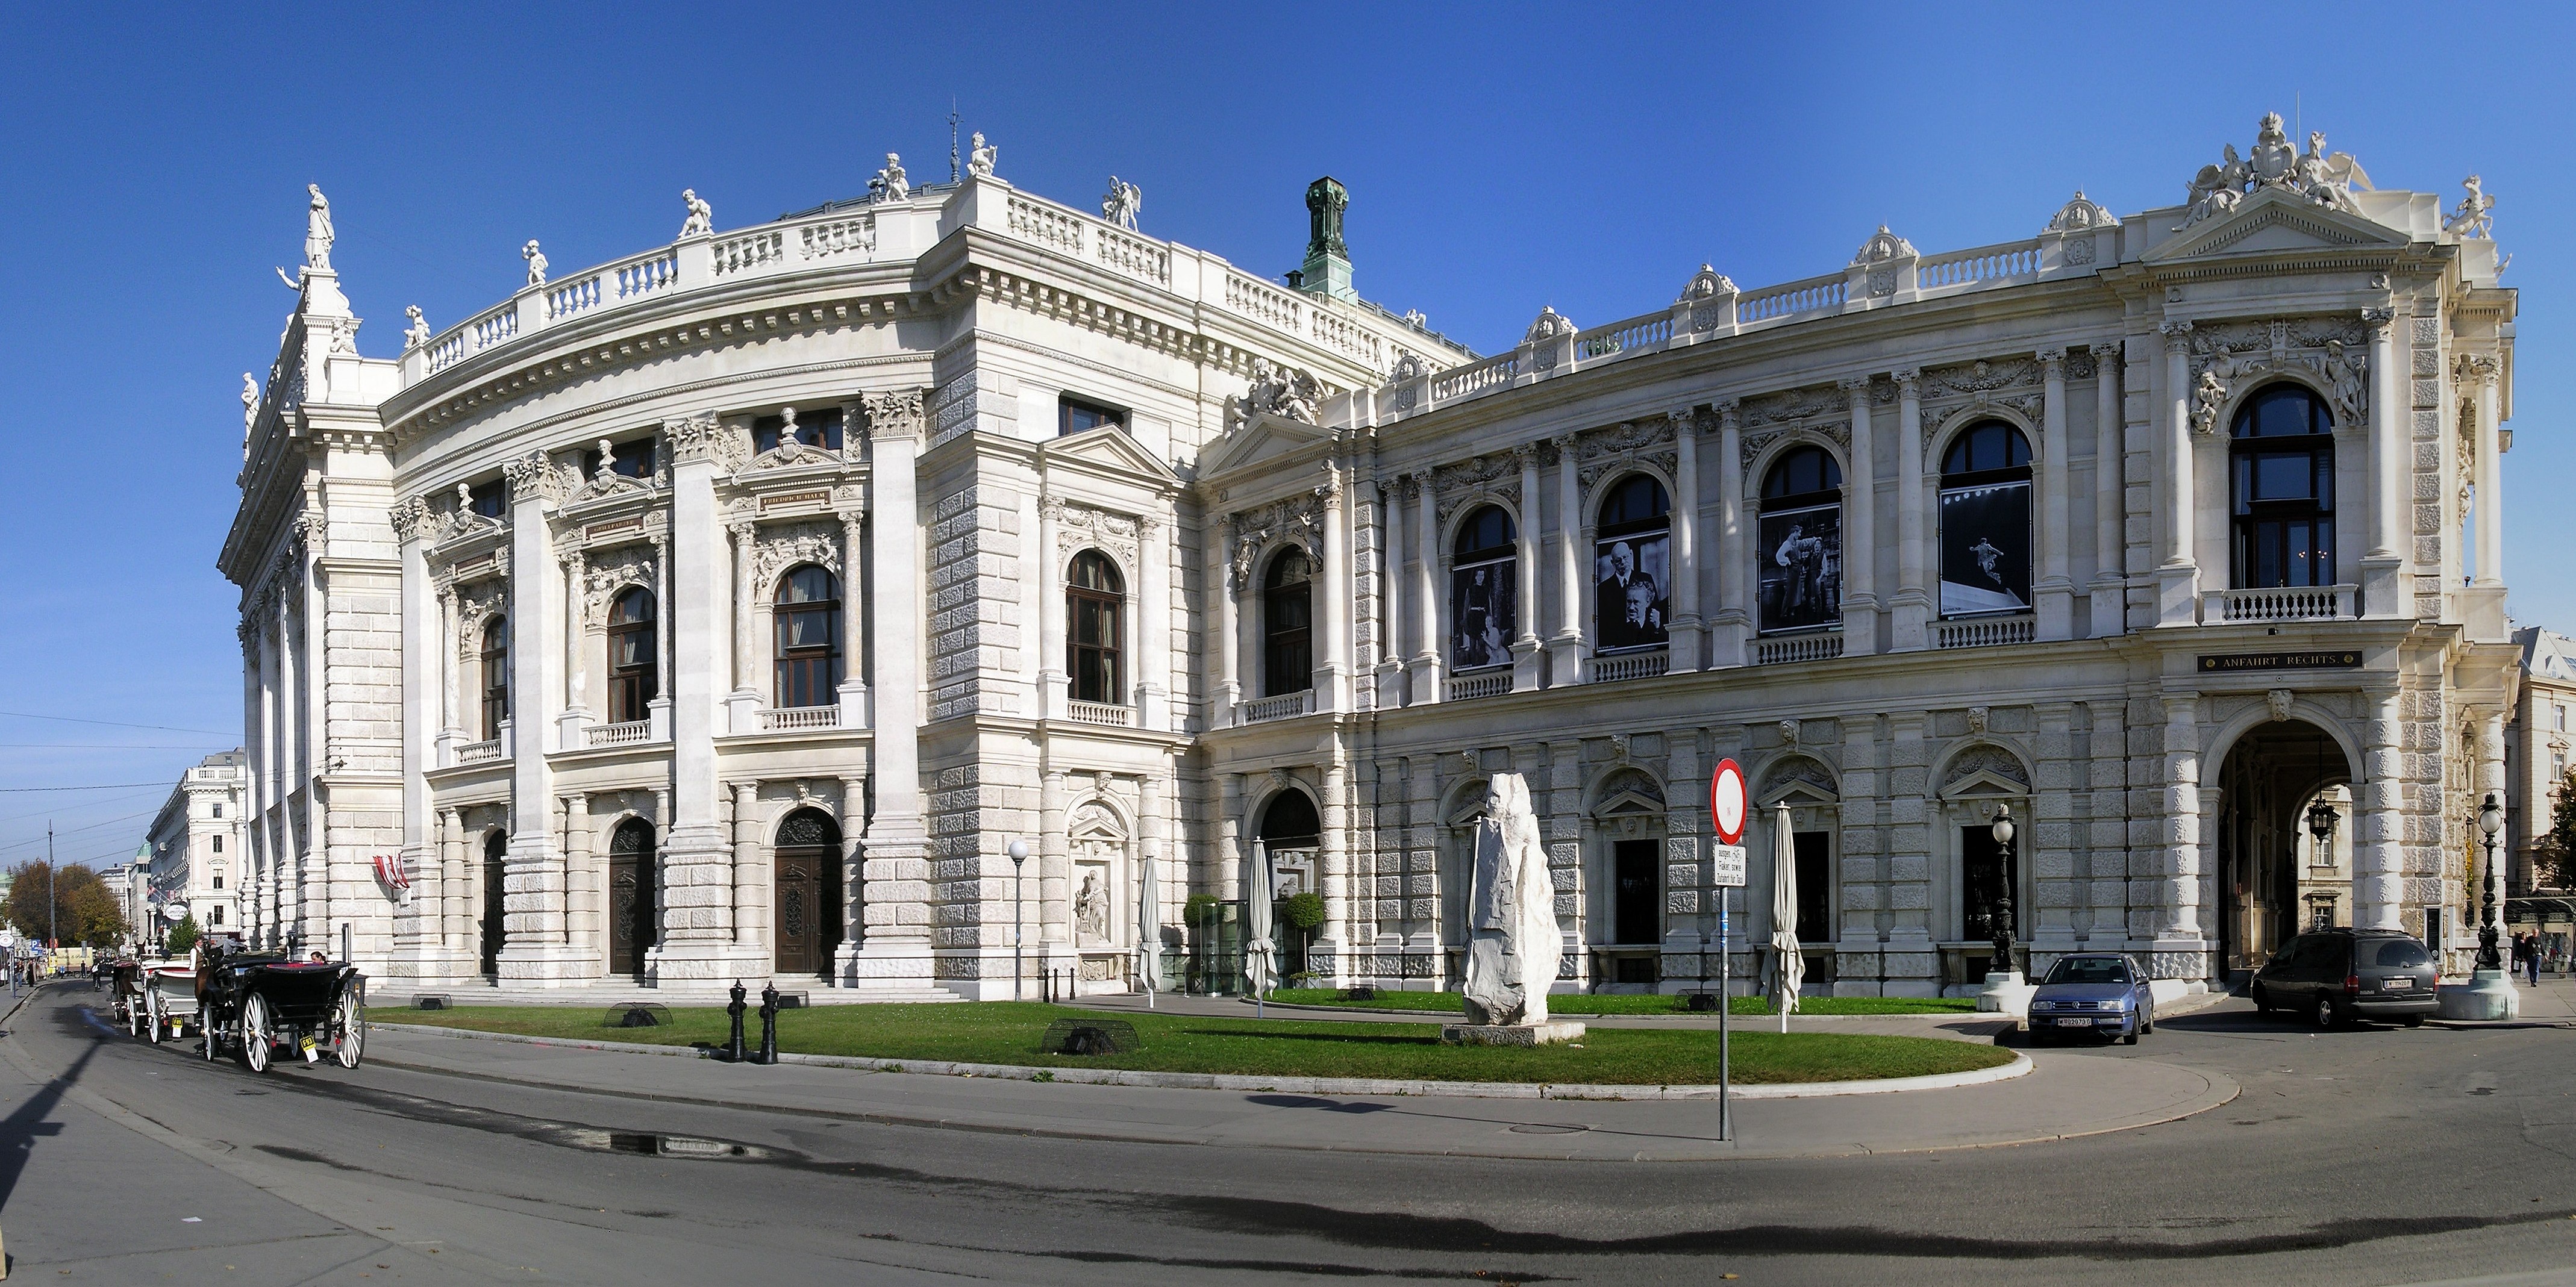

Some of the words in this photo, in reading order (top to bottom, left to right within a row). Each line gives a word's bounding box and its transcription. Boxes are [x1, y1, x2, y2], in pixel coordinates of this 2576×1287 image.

[764, 495, 801, 504] FRIEDRICH
[2222, 656, 2278, 668] ANFAHRT
[2287, 655, 2340, 665] RECHTS.
[302, 1037, 312, 1047] F93
